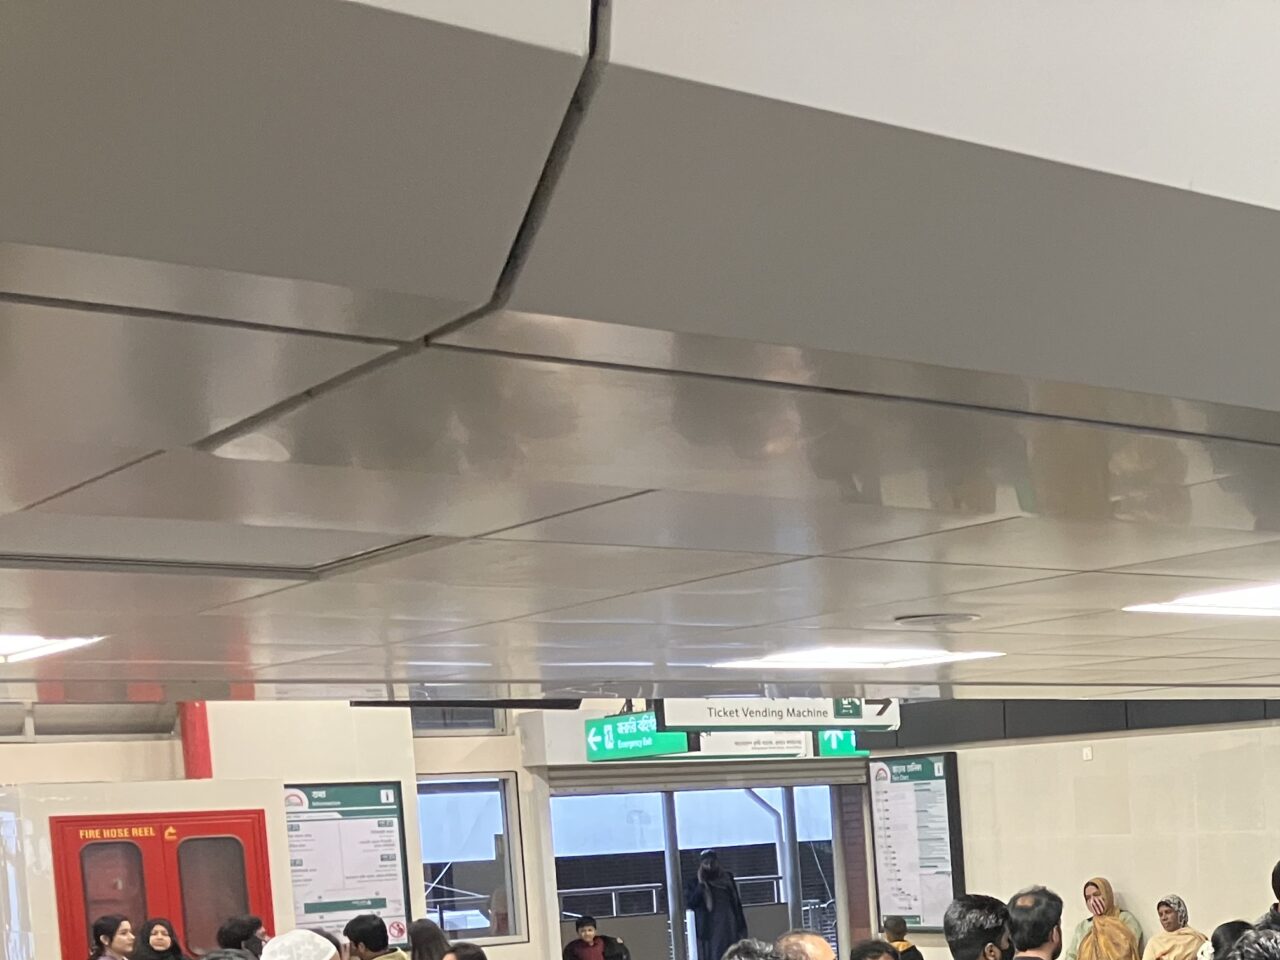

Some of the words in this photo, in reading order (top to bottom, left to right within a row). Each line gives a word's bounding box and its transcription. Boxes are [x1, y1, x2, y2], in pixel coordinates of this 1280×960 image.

[707, 707, 739, 718] Ticket
[741, 706, 784, 719] Vending
[786, 705, 829, 718] Machine
[79, 829, 101, 839] FIRE
[102, 828, 130, 838] HOSE
[131, 827, 156, 837] REEL
